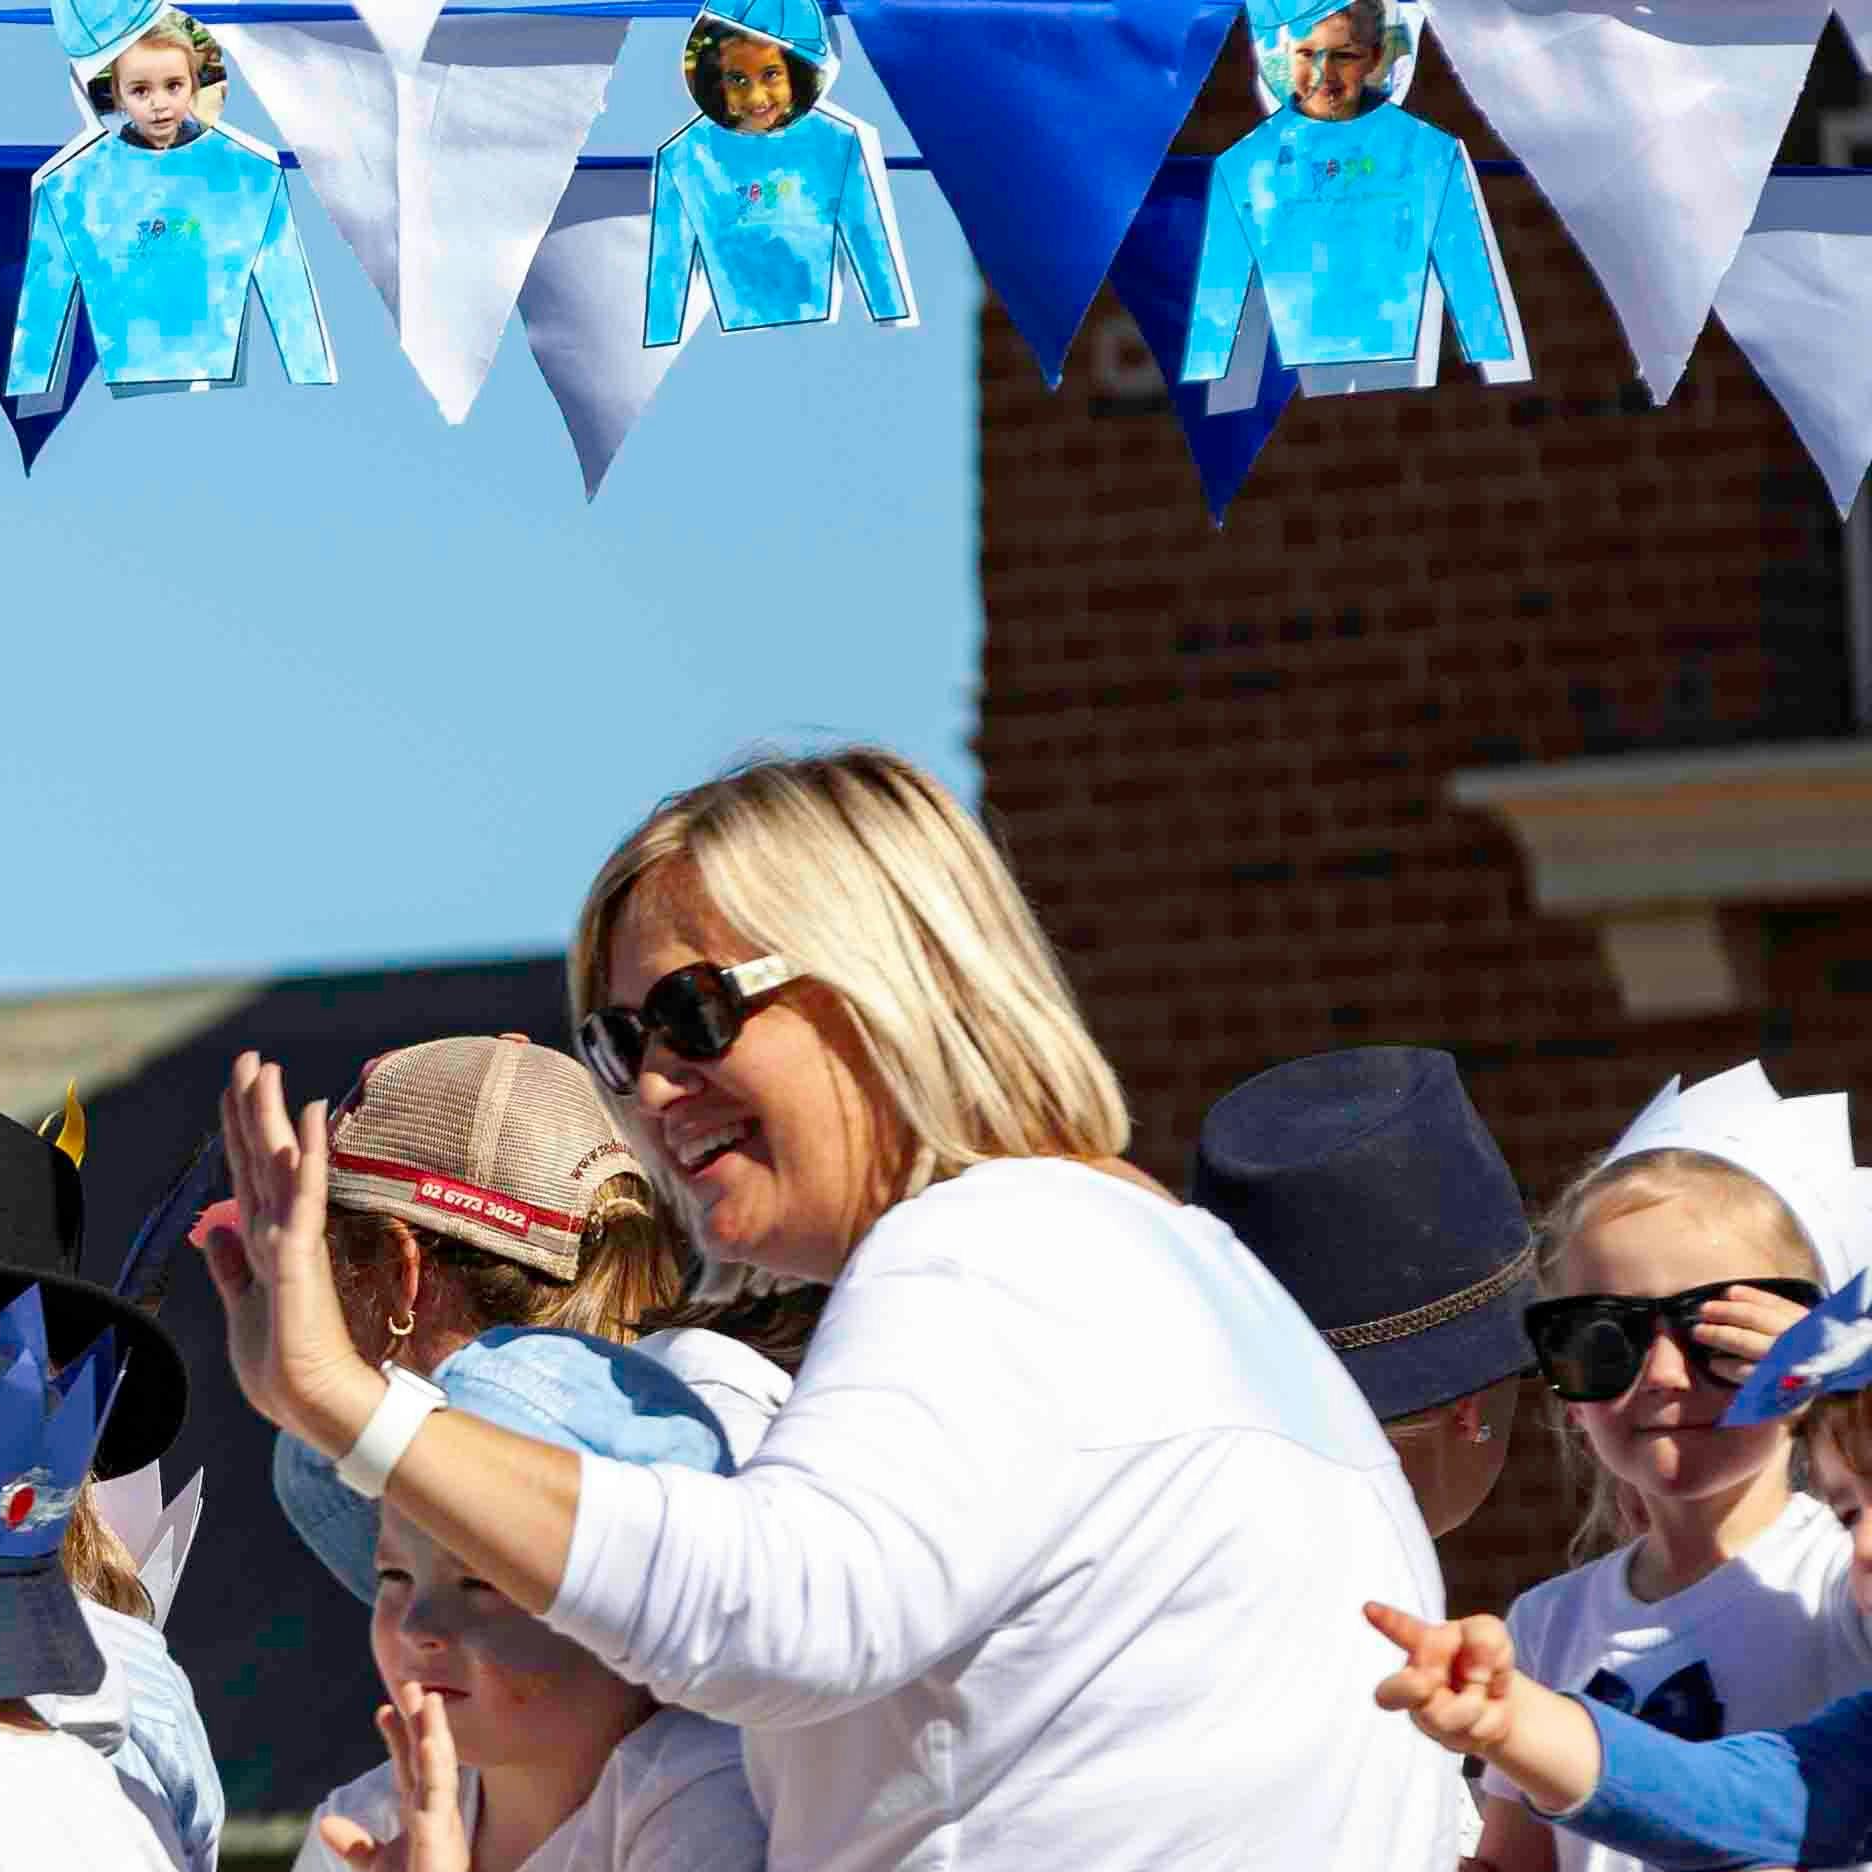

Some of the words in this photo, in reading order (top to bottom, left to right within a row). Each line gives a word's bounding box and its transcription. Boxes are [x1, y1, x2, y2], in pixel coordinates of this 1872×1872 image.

[421, 1183, 443, 1199] 02
[444, 1190, 484, 1211] 6773
[484, 1201, 527, 1227] 3022
